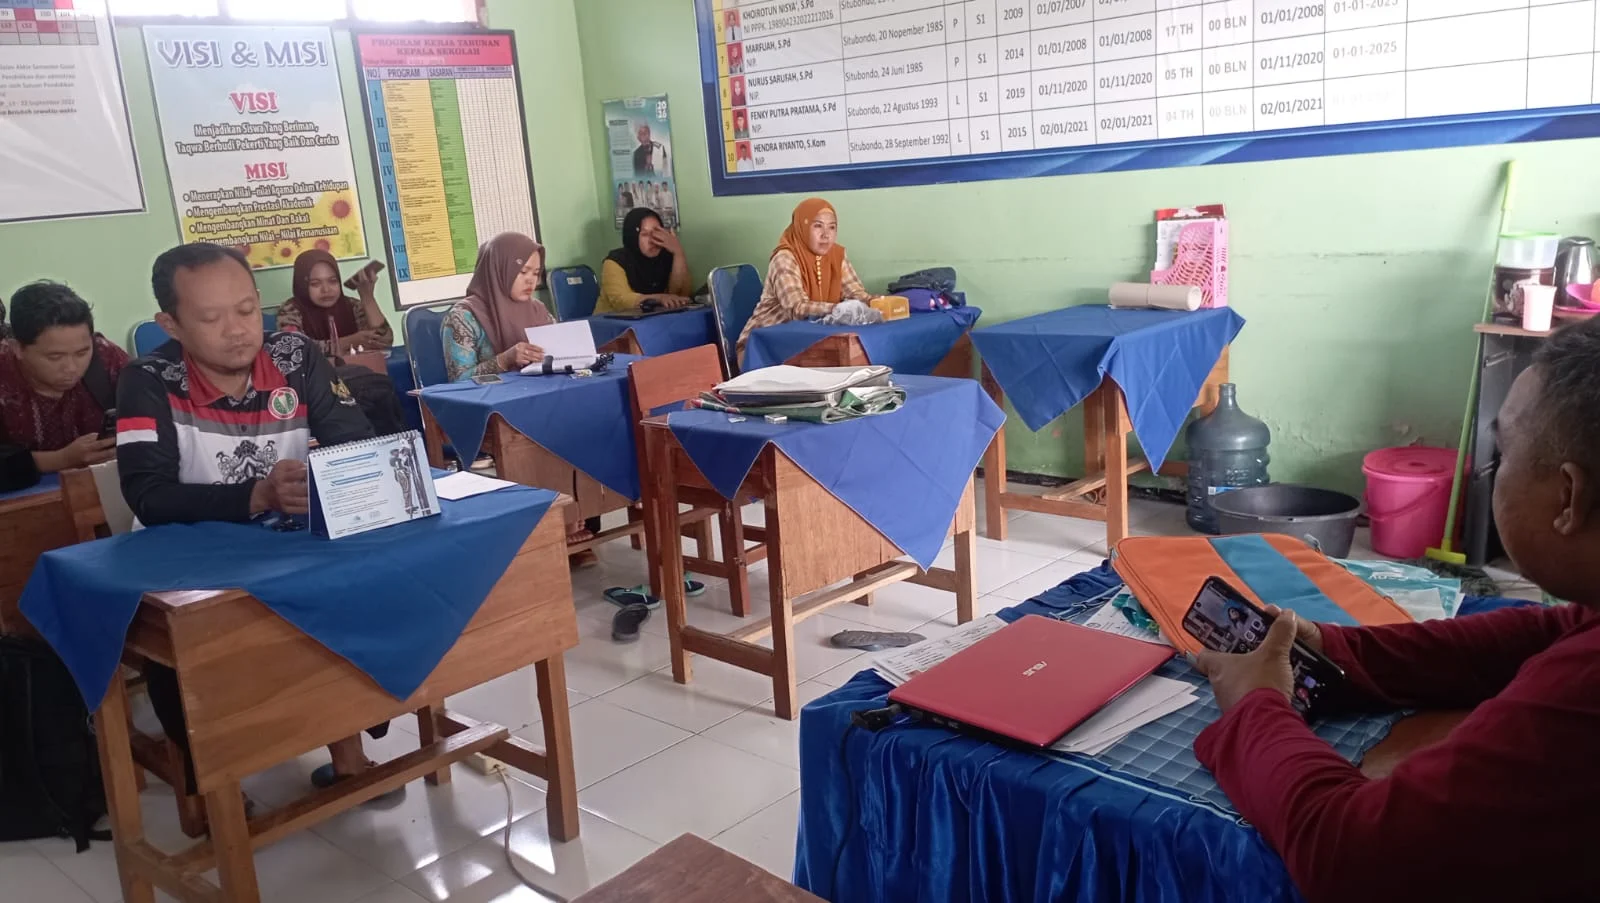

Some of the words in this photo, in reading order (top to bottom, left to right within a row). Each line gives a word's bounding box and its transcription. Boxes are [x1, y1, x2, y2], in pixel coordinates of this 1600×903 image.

[743, 5, 777, 20] KHOIROTUN
[976, 14, 986, 25] S1
[1003, 7, 1023, 20] 2009
[1261, 5, 1324, 25] 01/01/2008
[953, 18, 958, 28] P
[1209, 20, 1221, 31] 00
[1224, 16, 1247, 29] BLN
[843, 33, 877, 46] Situbondo,
[879, 30, 888, 41] 20
[888, 24, 924, 40] Nopember
[926, 20, 944, 33] 1985
[1099, 29, 1152, 47] 01/01/2008
[1166, 26, 1177, 38] 17
[1179, 24, 1194, 36] TH
[156, 40, 221, 67] VISI
[231, 40, 259, 67] &
[263, 40, 328, 67] MISI
[746, 43, 778, 54] MARFUAH,
[778, 39, 791, 49] S.Pd
[1005, 48, 1024, 60] 2014
[1038, 39, 1087, 56] 01/01/2008
[1333, 41, 1397, 59] 01-01-2025
[955, 57, 960, 67] P
[977, 53, 987, 64] S1
[1261, 51, 1324, 70] 01/11/2020
[387, 68, 421, 77] PROGRAM
[429, 68, 453, 77] SASARAN
[845, 69, 880, 82] Situbondo,
[881, 66, 890, 78] 24
[891, 64, 905, 76] Juni
[907, 62, 924, 74] 1985
[1165, 69, 1176, 80] 05
[1180, 68, 1194, 79] TH
[1209, 64, 1221, 75] 00
[1224, 61, 1247, 73] BLN
[748, 76, 769, 88] NURUS
[800, 70, 813, 80] S.Pd
[1099, 72, 1153, 89] 01/11/2020
[1006, 88, 1025, 100] 2019
[1038, 80, 1088, 97] 01/11/2020
[229, 91, 279, 113] VISI
[956, 95, 960, 105] L
[979, 91, 988, 102] S1
[751, 110, 769, 121] FENKY
[769, 107, 789, 118] PUTRA
[790, 105, 822, 117] PRATAMA,
[823, 102, 836, 113] S.Pd
[847, 104, 882, 117] Situbondo,
[883, 103, 891, 113] 22
[892, 101, 919, 114] Agustus
[921, 97, 938, 109] 1993
[1224, 105, 1247, 117] BLN
[1261, 98, 1323, 115] 02/01/2021
[1180, 109, 1194, 120] TH
[194, 124, 241, 138] Menjadikan
[242, 123, 265, 135] Siswa
[264, 122, 284, 135] Yang
[1040, 121, 1088, 136] 02/01/2021
[1101, 115, 1153, 130] 02/01/2021
[957, 132, 962, 143] L
[980, 130, 989, 141] S1
[1008, 127, 1027, 138] 2015
[175, 141, 203, 156] Taqwa
[203, 139, 236, 152] Berbudi
[236, 138, 264, 151] Pekerti
[263, 137, 284, 151] Yang
[284, 137, 301, 148] Baik
[301, 136, 315, 147] Dan
[315, 134, 340, 146] Cerdas
[754, 142, 778, 153] HENDRA
[778, 140, 806, 152] RIYANTO,
[807, 139, 826, 149] S.Kom
[850, 139, 884, 152] Situbondo,
[885, 138, 894, 148] 28
[894, 134, 930, 149] September
[932, 133, 949, 145] 1992
[244, 161, 288, 181] MISI
[383, 165, 393, 176] IV
[190, 189, 233, 203] Menerapkan
[234, 187, 251, 199] Nilai
[271, 184, 294, 197] Agama
[294, 182, 315, 194] Dalam
[315, 180, 349, 193] Kehidupan
[387, 184, 393, 194] V
[193, 203, 253, 219] Mengembangkan
[253, 201, 281, 213] Prestasi
[280, 198, 314, 210] Akademik
[388, 201, 399, 212] VI
[196, 219, 255, 234] Mengembangkan
[255, 216, 277, 229] Minat
[276, 215, 290, 227] Dan
[290, 213, 310, 225] Bakat
[258, 231, 275, 243] Nilai
[281, 228, 297, 240] Nilai
[296, 226, 339, 239] Kemanusiaan
[398, 267, 409, 279] IX
